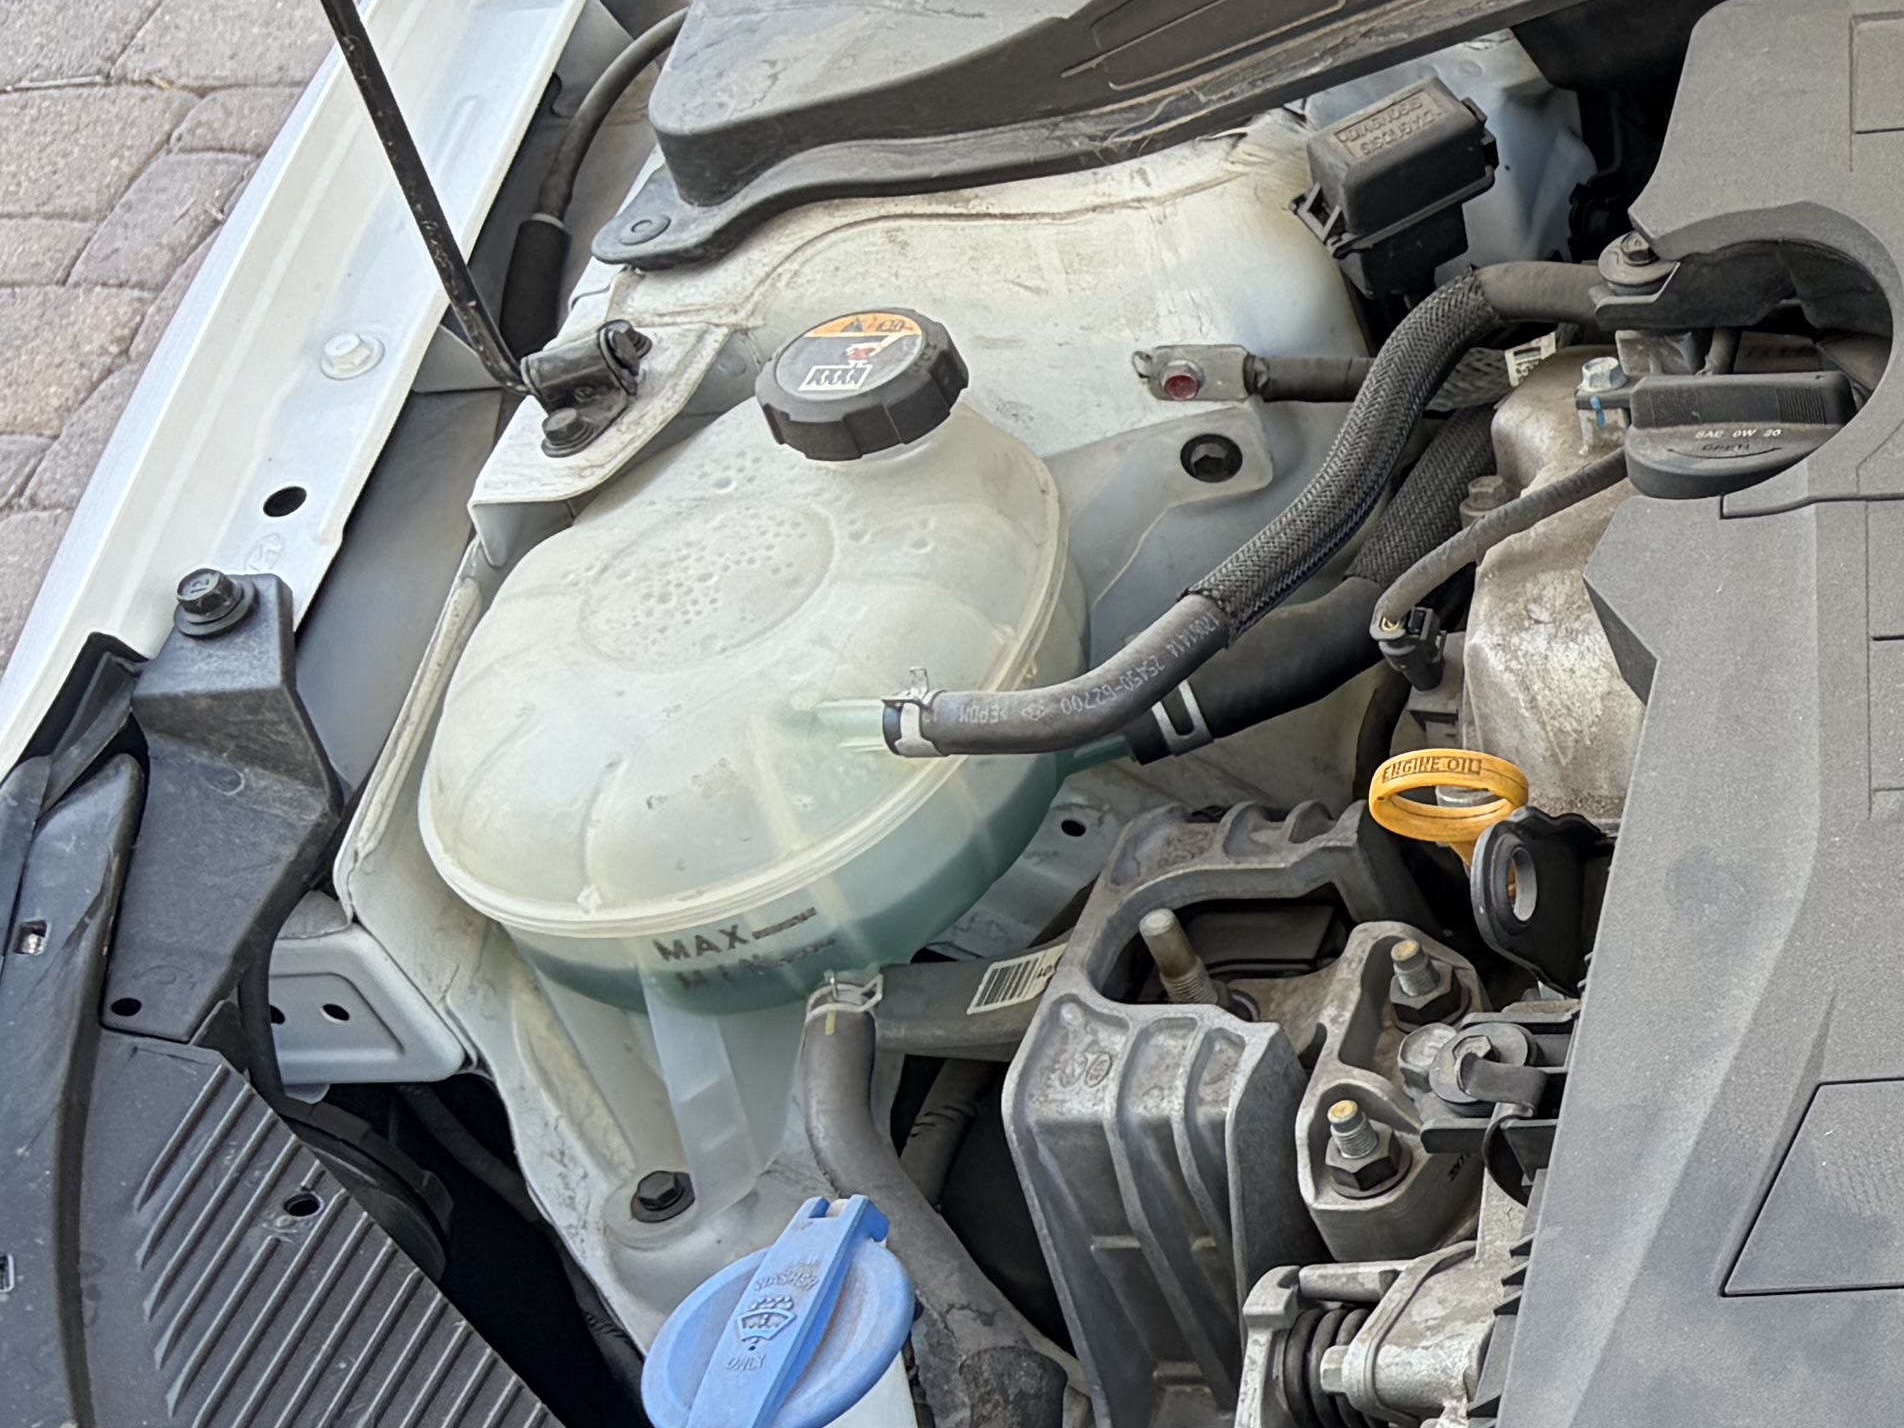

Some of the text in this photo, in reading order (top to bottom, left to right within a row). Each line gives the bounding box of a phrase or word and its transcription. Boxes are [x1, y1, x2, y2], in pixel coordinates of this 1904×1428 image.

[1382, 757, 1481, 782] ENGINE OIL
[652, 924, 750, 962] MAX
[726, 1353, 767, 1371] ONLY
